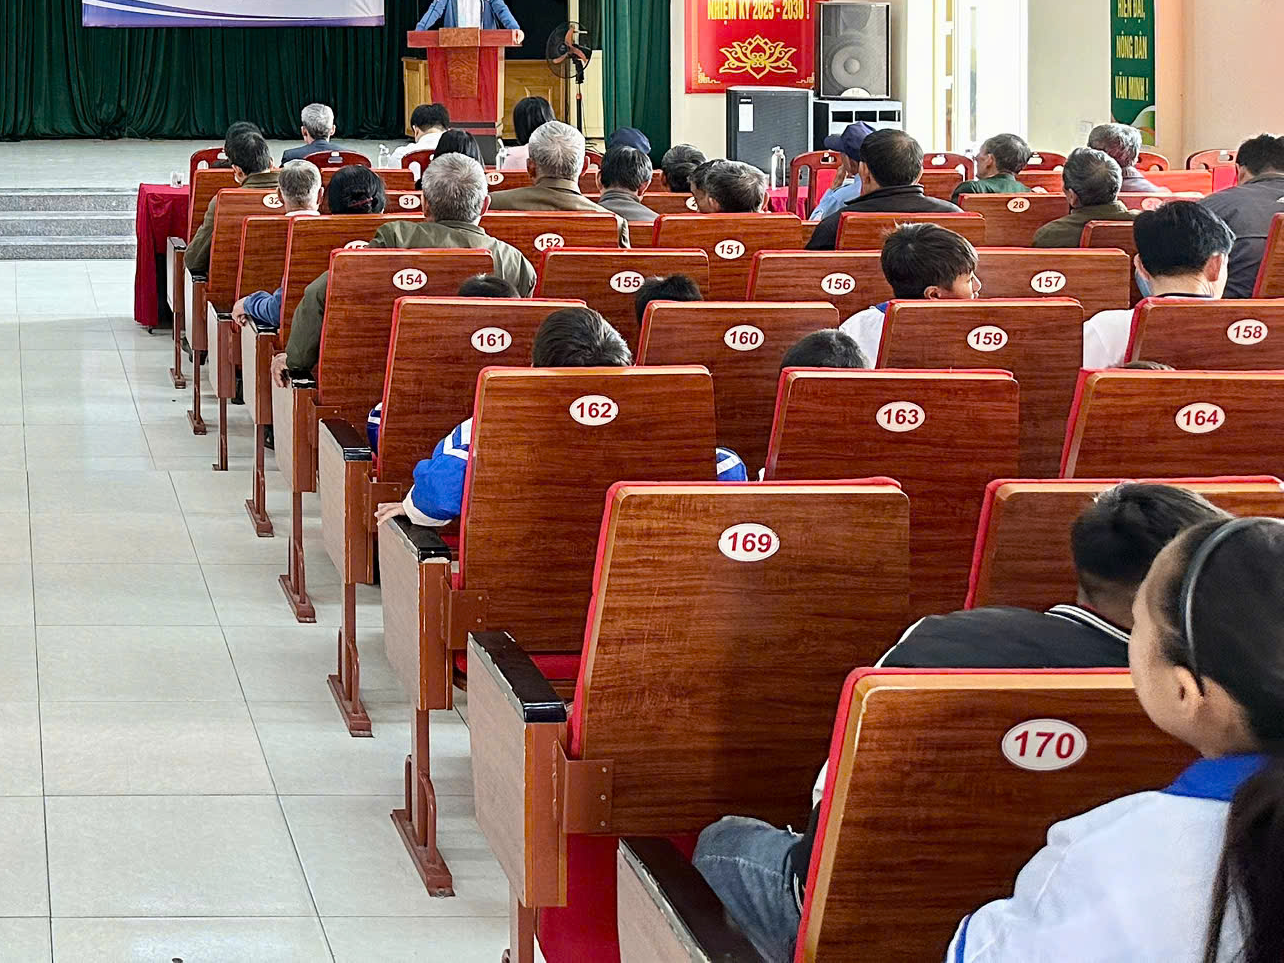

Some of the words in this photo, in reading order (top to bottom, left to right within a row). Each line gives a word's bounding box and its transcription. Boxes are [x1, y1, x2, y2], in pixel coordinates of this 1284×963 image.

[489, 174, 499, 183] 19
[404, 197, 415, 206] 31
[1013, 201, 1025, 210] 28
[539, 237, 561, 248] 152
[719, 244, 741, 255] 151
[398, 274, 423, 286] 154
[615, 276, 641, 288] 155
[826, 278, 851, 290] 156
[1036, 276, 1062, 288] 157
[1233, 325, 1263, 339] 158
[477, 334, 506, 347] 161
[729, 332, 759, 345] 160
[973, 332, 1003, 346] 159
[576, 402, 612, 419] 162
[883, 408, 918, 425] 163
[1182, 410, 1219, 426] 164
[726, 531, 773, 555] 169
[1013, 731, 1076, 761] 170
